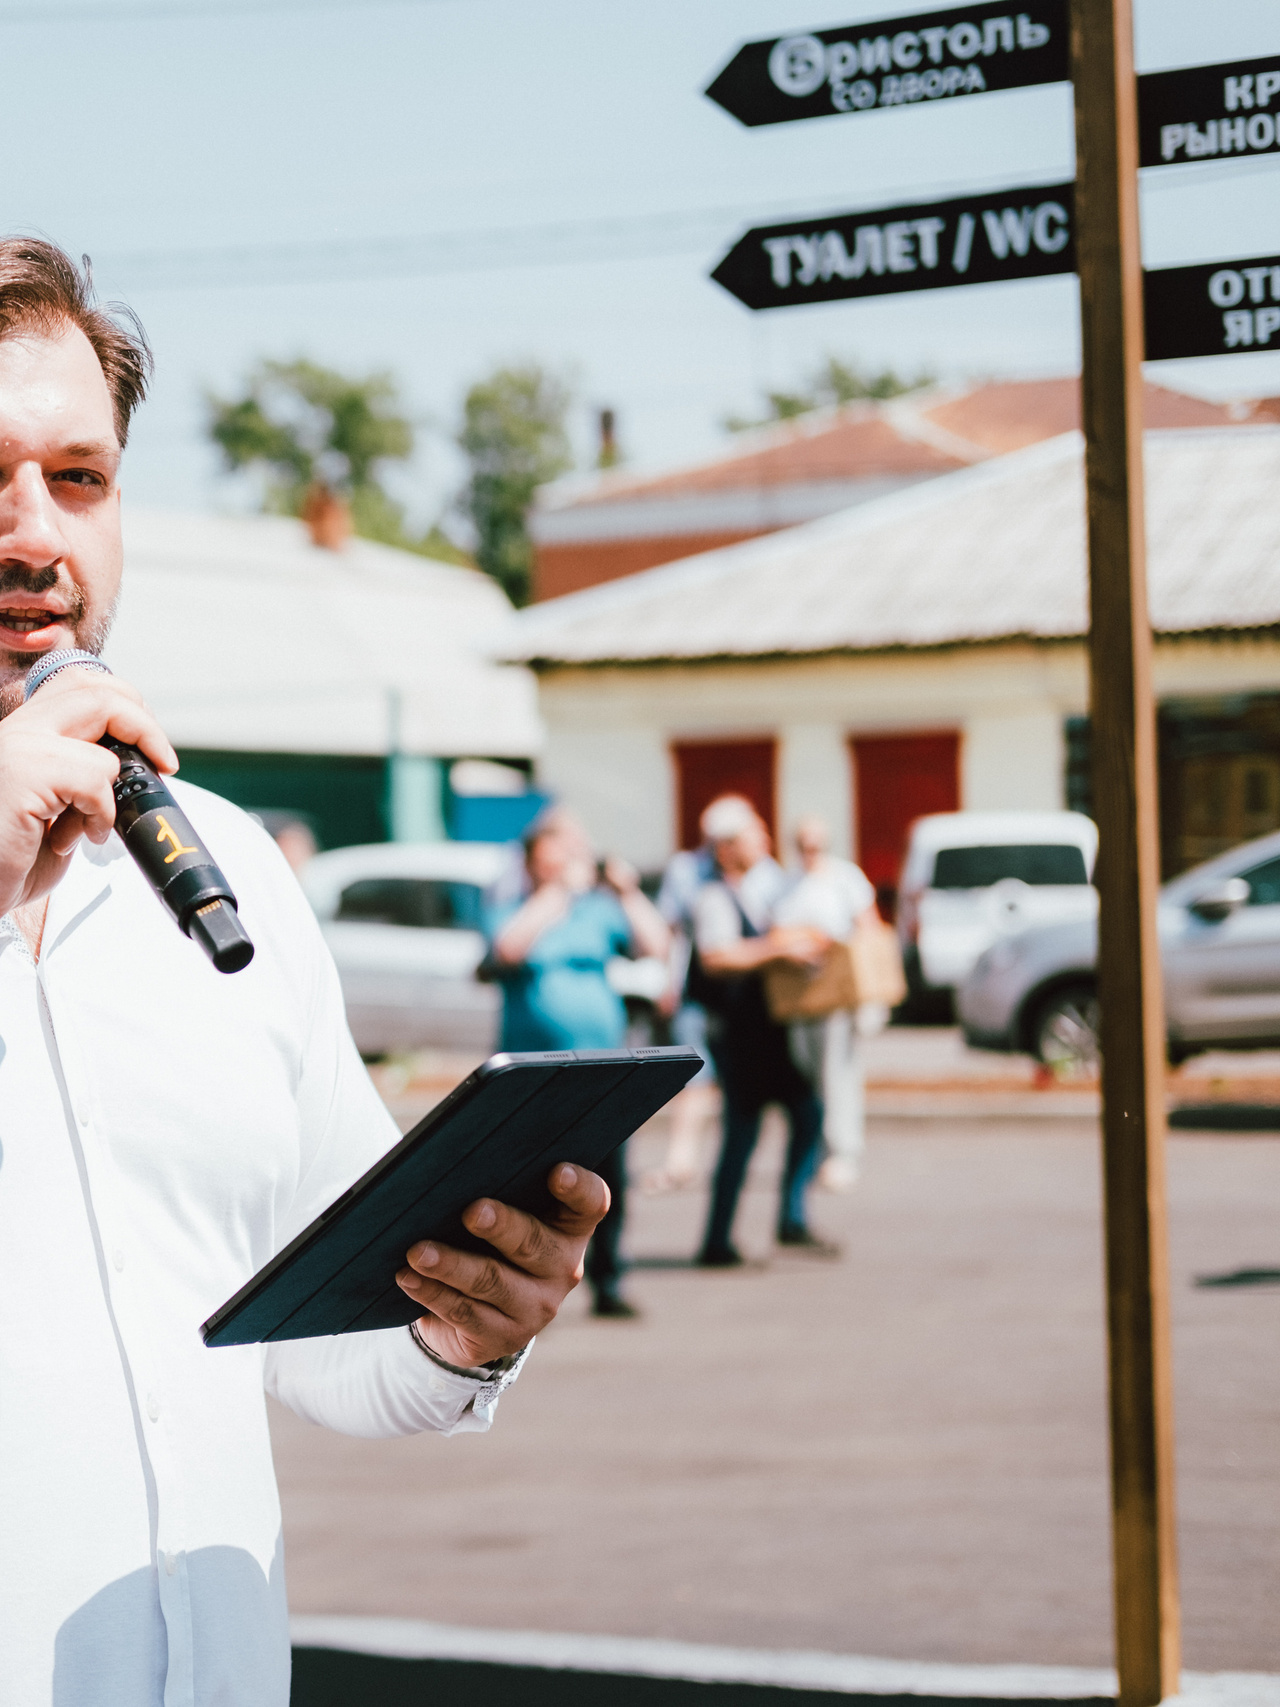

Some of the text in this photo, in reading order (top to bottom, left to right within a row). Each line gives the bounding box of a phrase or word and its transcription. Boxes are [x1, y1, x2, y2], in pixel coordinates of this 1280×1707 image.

[831, 63, 986, 112] СО ДВОРА
[1160, 111, 1280, 161] РЫНО
[762, 216, 946, 288] ТУАЛЕТ
[981, 201, 1068, 260] WC
[156, 814, 198, 863] 1
